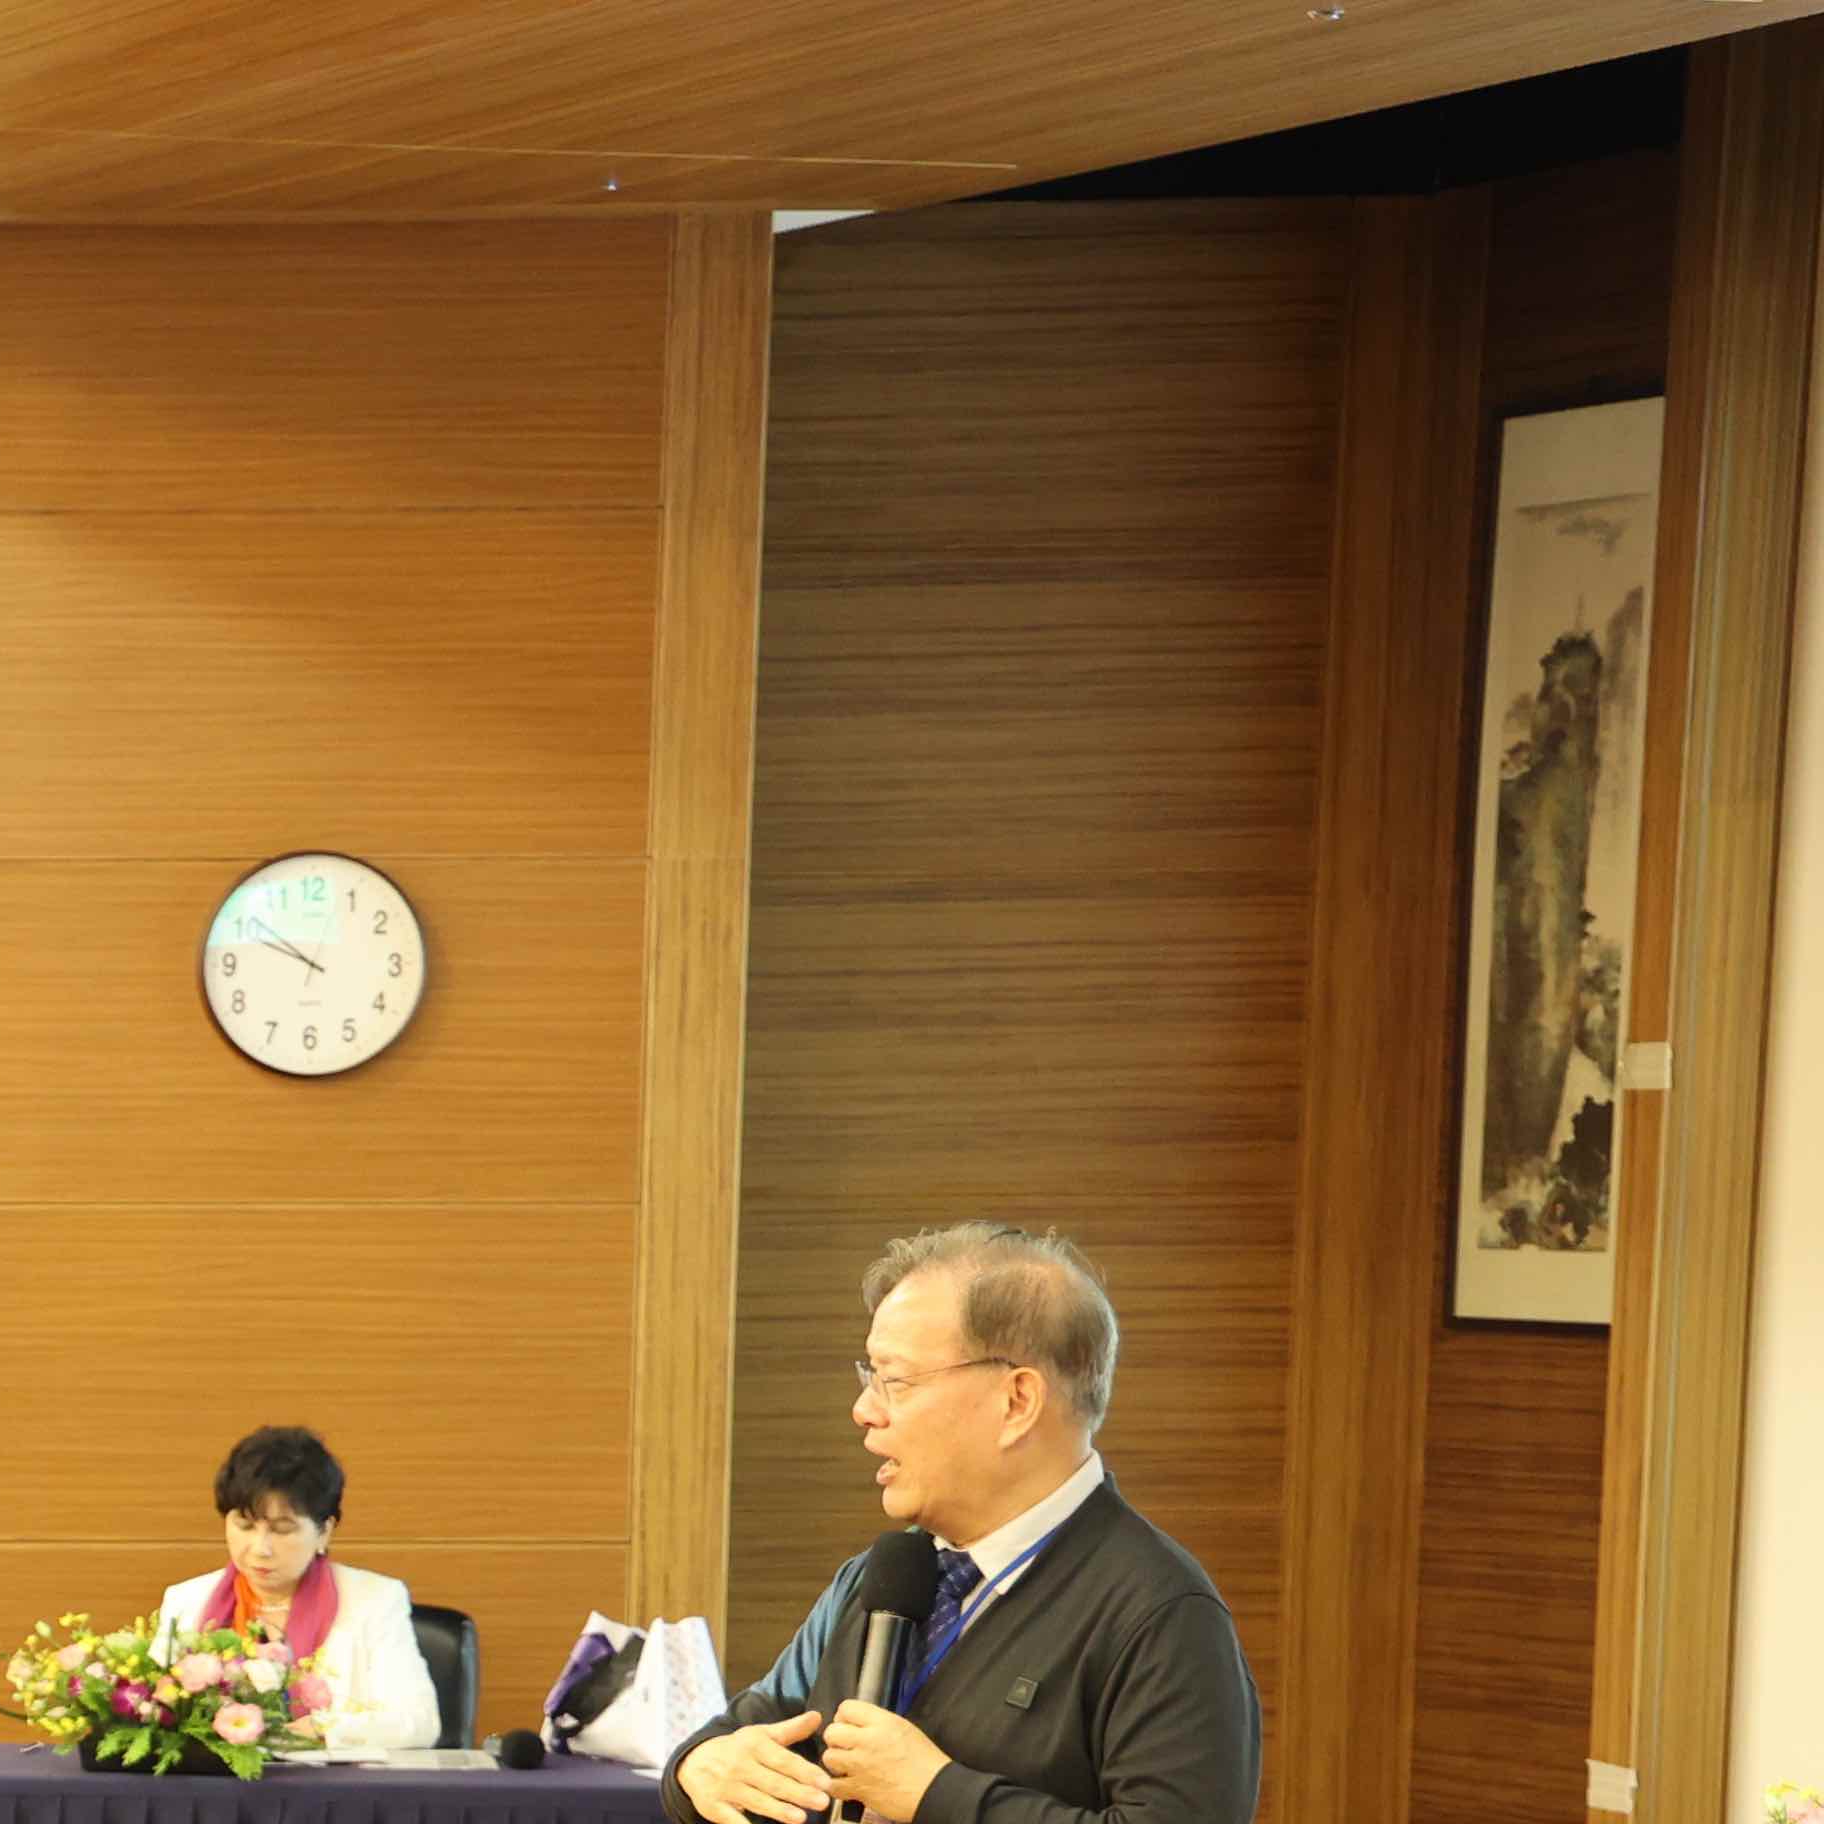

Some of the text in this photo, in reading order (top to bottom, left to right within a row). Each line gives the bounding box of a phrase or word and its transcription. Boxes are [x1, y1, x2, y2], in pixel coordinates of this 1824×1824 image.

[301, 876, 326, 901] 12
[347, 889, 356, 912] 1
[372, 910, 389, 934] 2
[221, 952, 237, 977] 9
[387, 952, 403, 977] 3
[231, 989, 246, 1014] 8
[371, 991, 386, 1014] 4
[264, 1021, 279, 1045] 7
[302, 1025, 318, 1050] 6
[342, 1018, 357, 1042] 5
